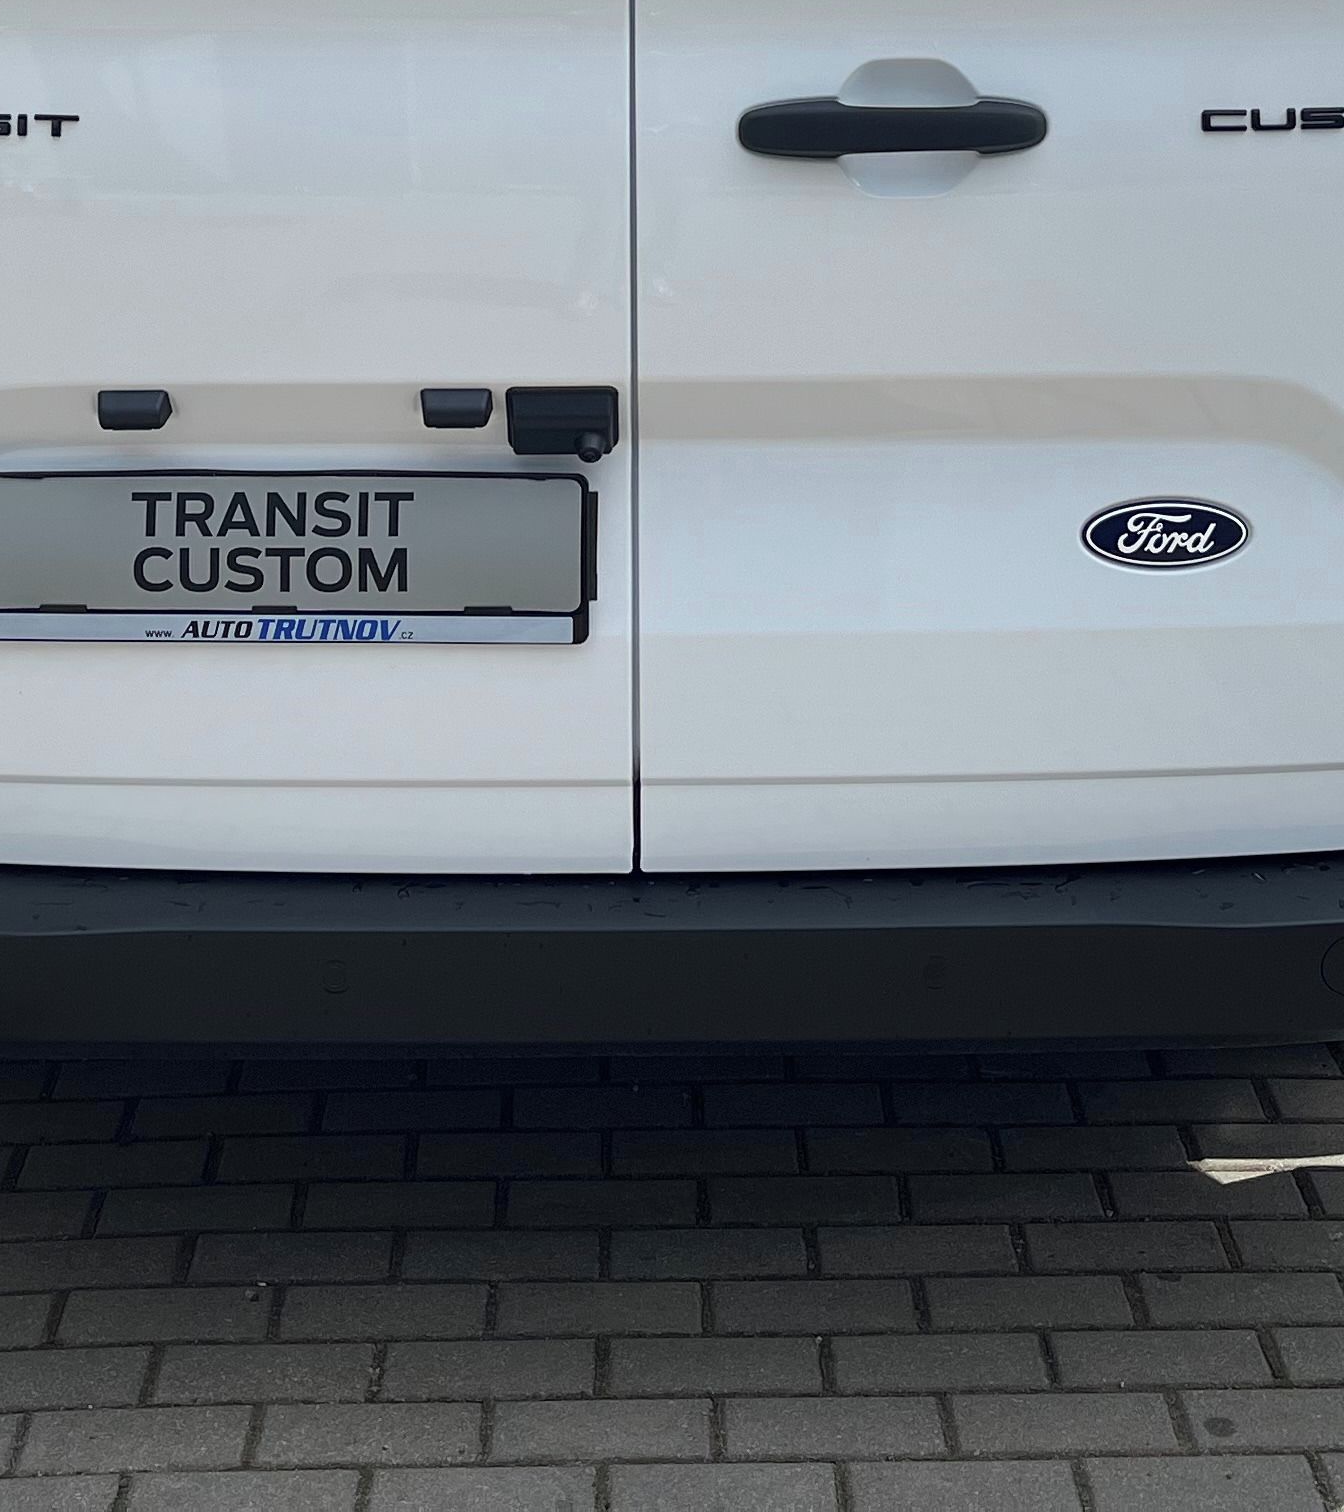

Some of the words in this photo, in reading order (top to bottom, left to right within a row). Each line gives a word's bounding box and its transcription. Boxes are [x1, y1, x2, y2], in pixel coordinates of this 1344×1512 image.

[131, 491, 414, 537] TRANSIT
[1117, 512, 1217, 554] Ford
[133, 546, 408, 593] CUSTOM
